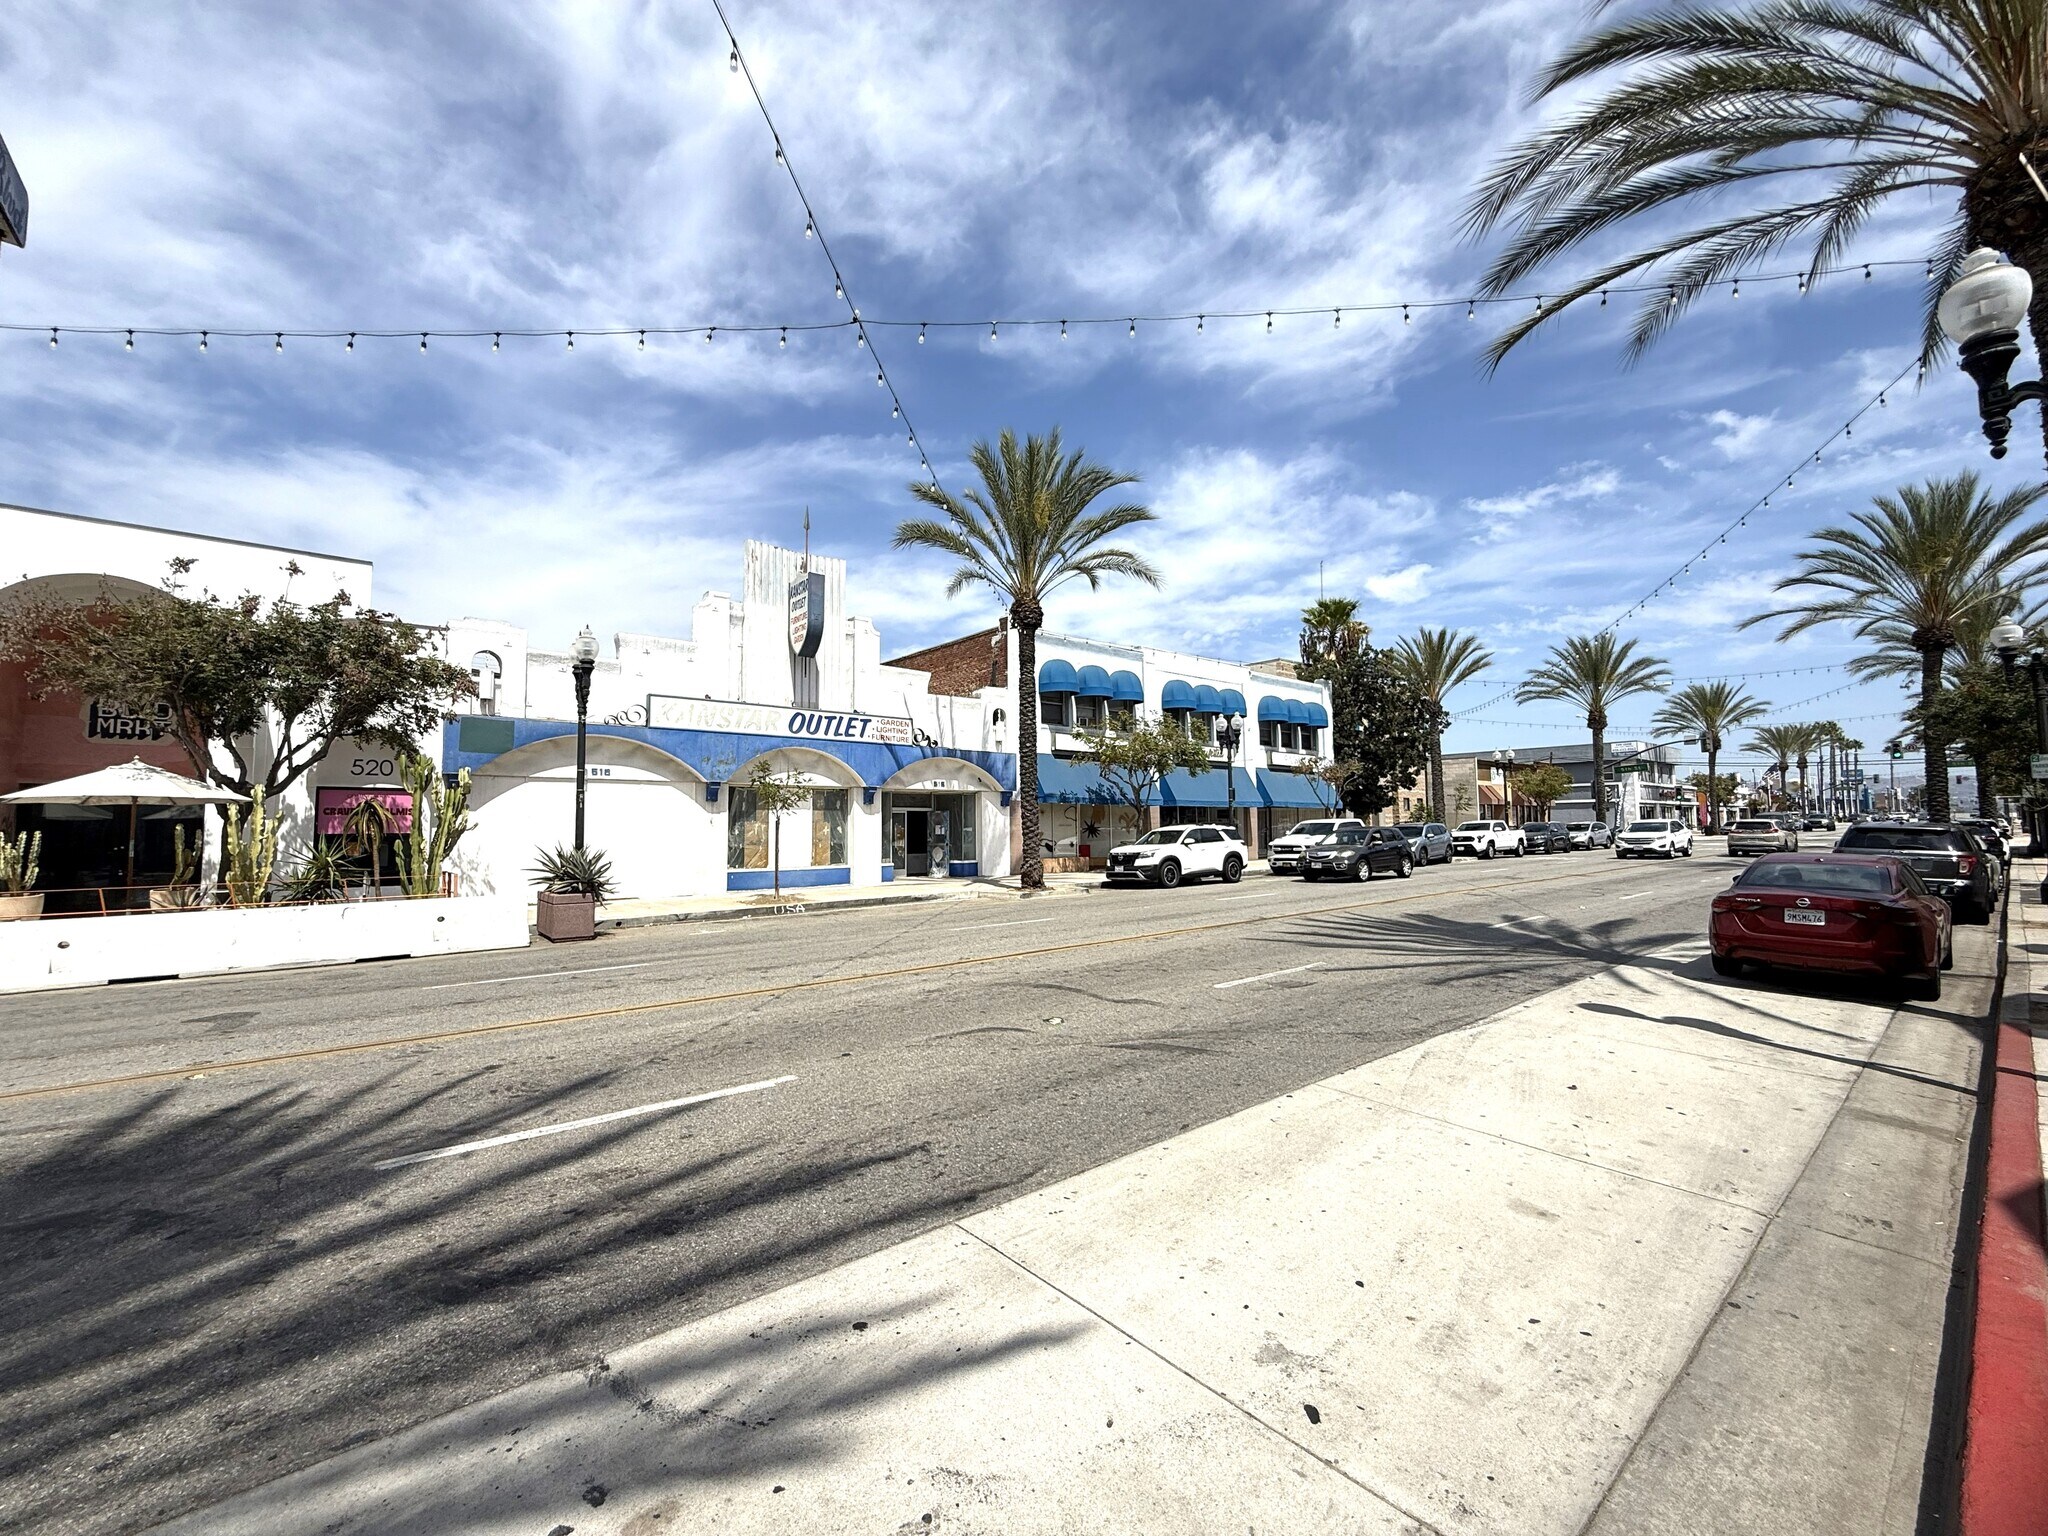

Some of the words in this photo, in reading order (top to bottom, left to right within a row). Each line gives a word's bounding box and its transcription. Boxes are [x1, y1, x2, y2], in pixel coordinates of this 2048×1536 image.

[791, 596, 807, 612] OUTLET
[790, 611, 808, 625] FURNITURE
[97, 698, 173, 720] BLD
[788, 712, 872, 738] OUTLET
[880, 719, 910, 728] GARDEN
[876, 726, 908, 735] LIGHTING
[871, 733, 910, 743] FURNITURE
[350, 758, 394, 776] 520
[774, 904, 806, 914] USA
[1787, 912, 1822, 923] 9MSM476
